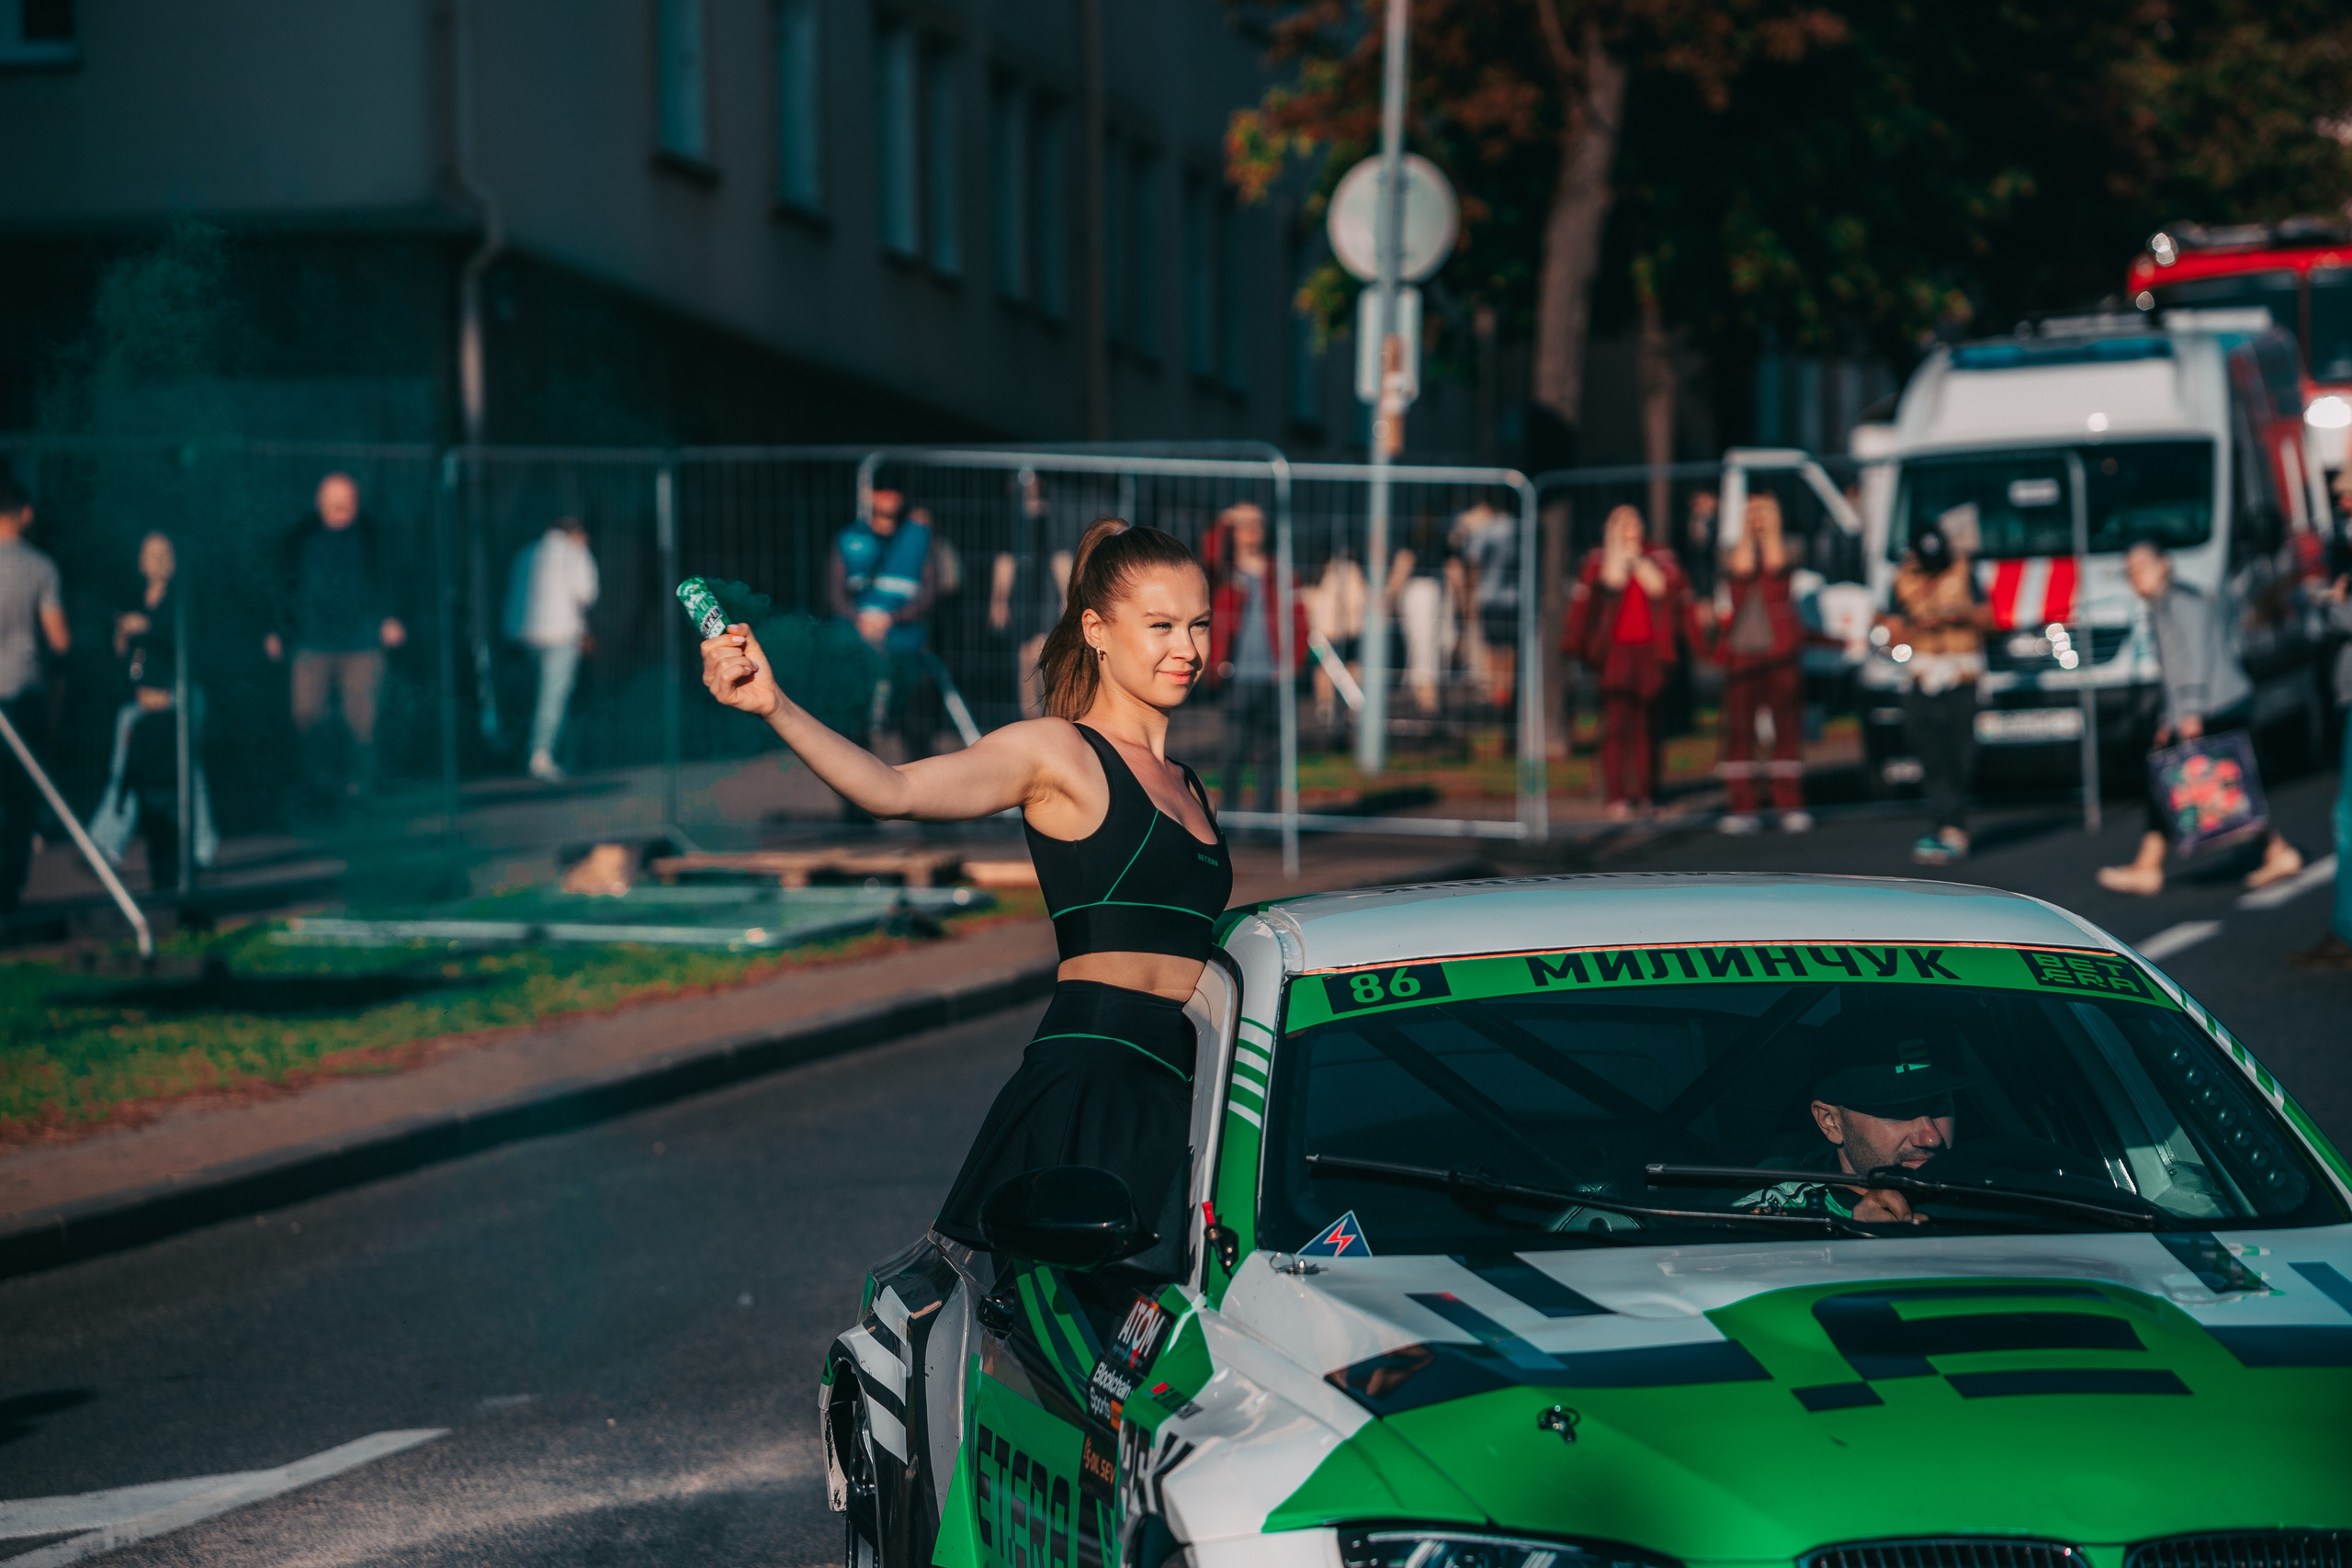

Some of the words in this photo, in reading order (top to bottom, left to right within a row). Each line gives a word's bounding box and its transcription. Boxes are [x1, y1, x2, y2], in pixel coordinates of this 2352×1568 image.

[1524, 947, 1962, 987] МИЛИНЧУК
[2031, 953, 2123, 976] BET
[2041, 967, 2141, 993] ERA
[1349, 966, 1421, 1003] 86
[1117, 1300, 1166, 1358] ATOM
[1092, 1361, 1131, 1401] Blockchain
[1090, 1385, 1111, 1419] Sports
